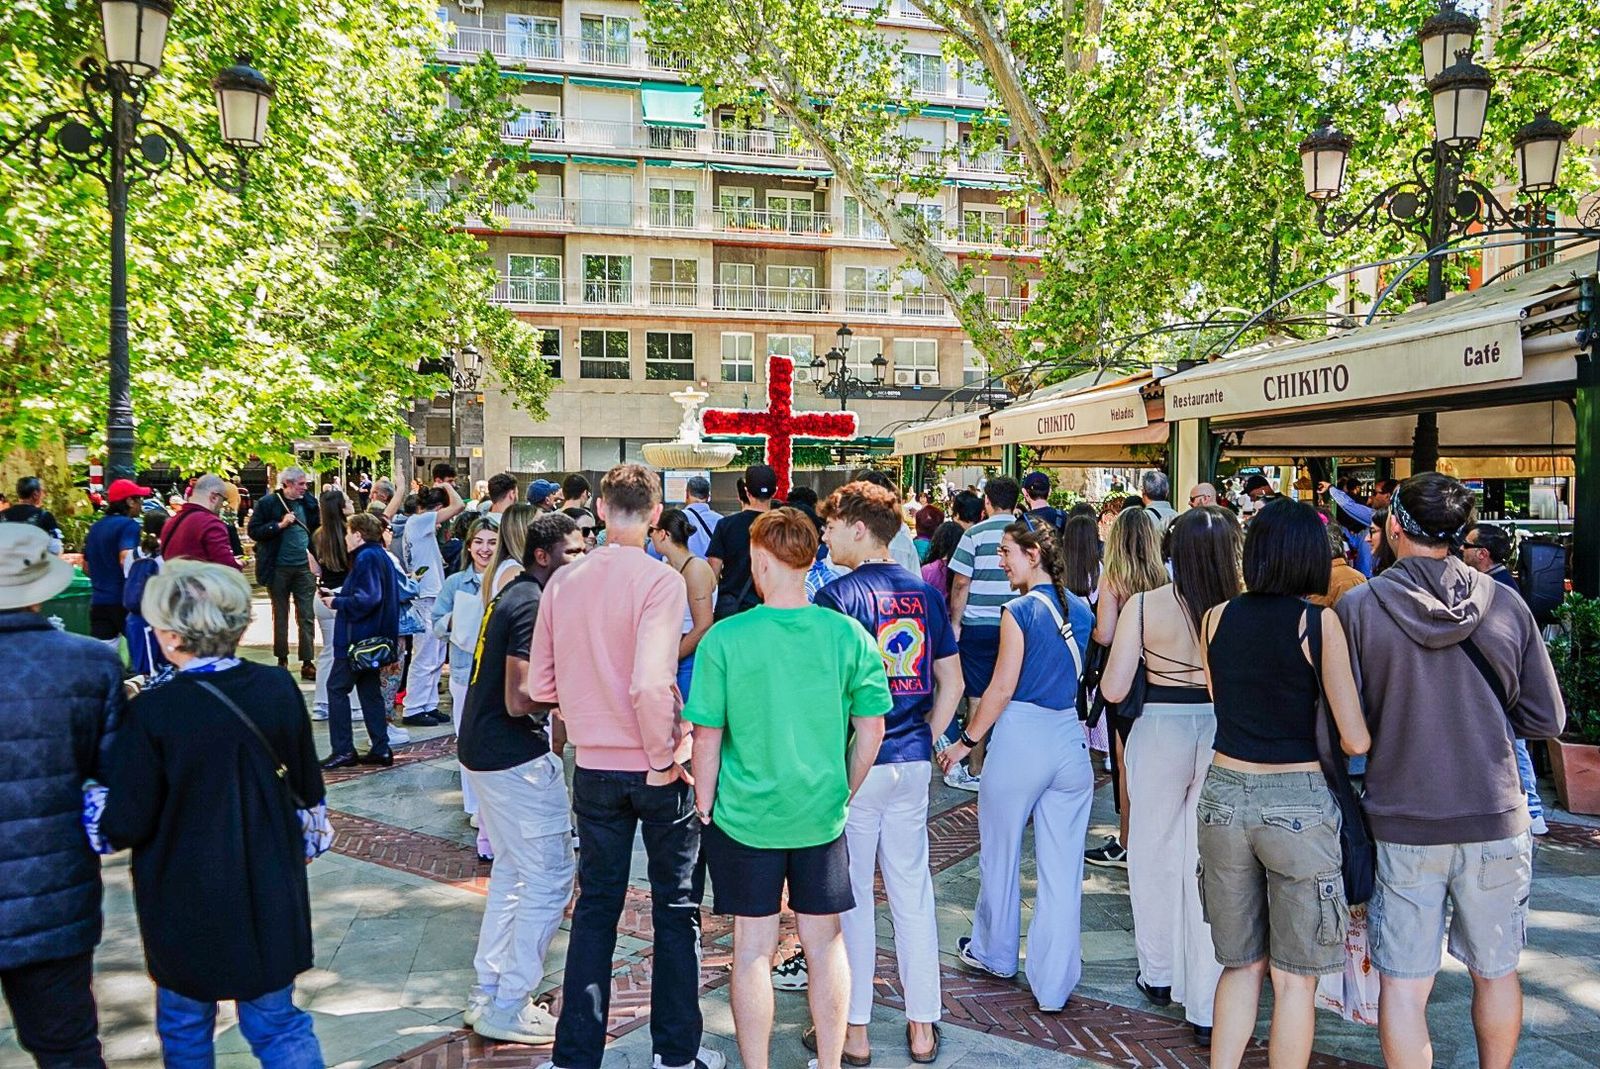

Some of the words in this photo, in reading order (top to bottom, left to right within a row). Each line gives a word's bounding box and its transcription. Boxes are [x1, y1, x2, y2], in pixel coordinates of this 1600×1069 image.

[1172, 388, 1224, 409] Restaurante
[1263, 363, 1350, 402] CHIKITO
[1464, 341, 1500, 367] Café
[1037, 412, 1076, 434] CHIKITO
[1110, 407, 1134, 422] Helados
[880, 597, 924, 616] CASA
[890, 679, 924, 691] ANCA
